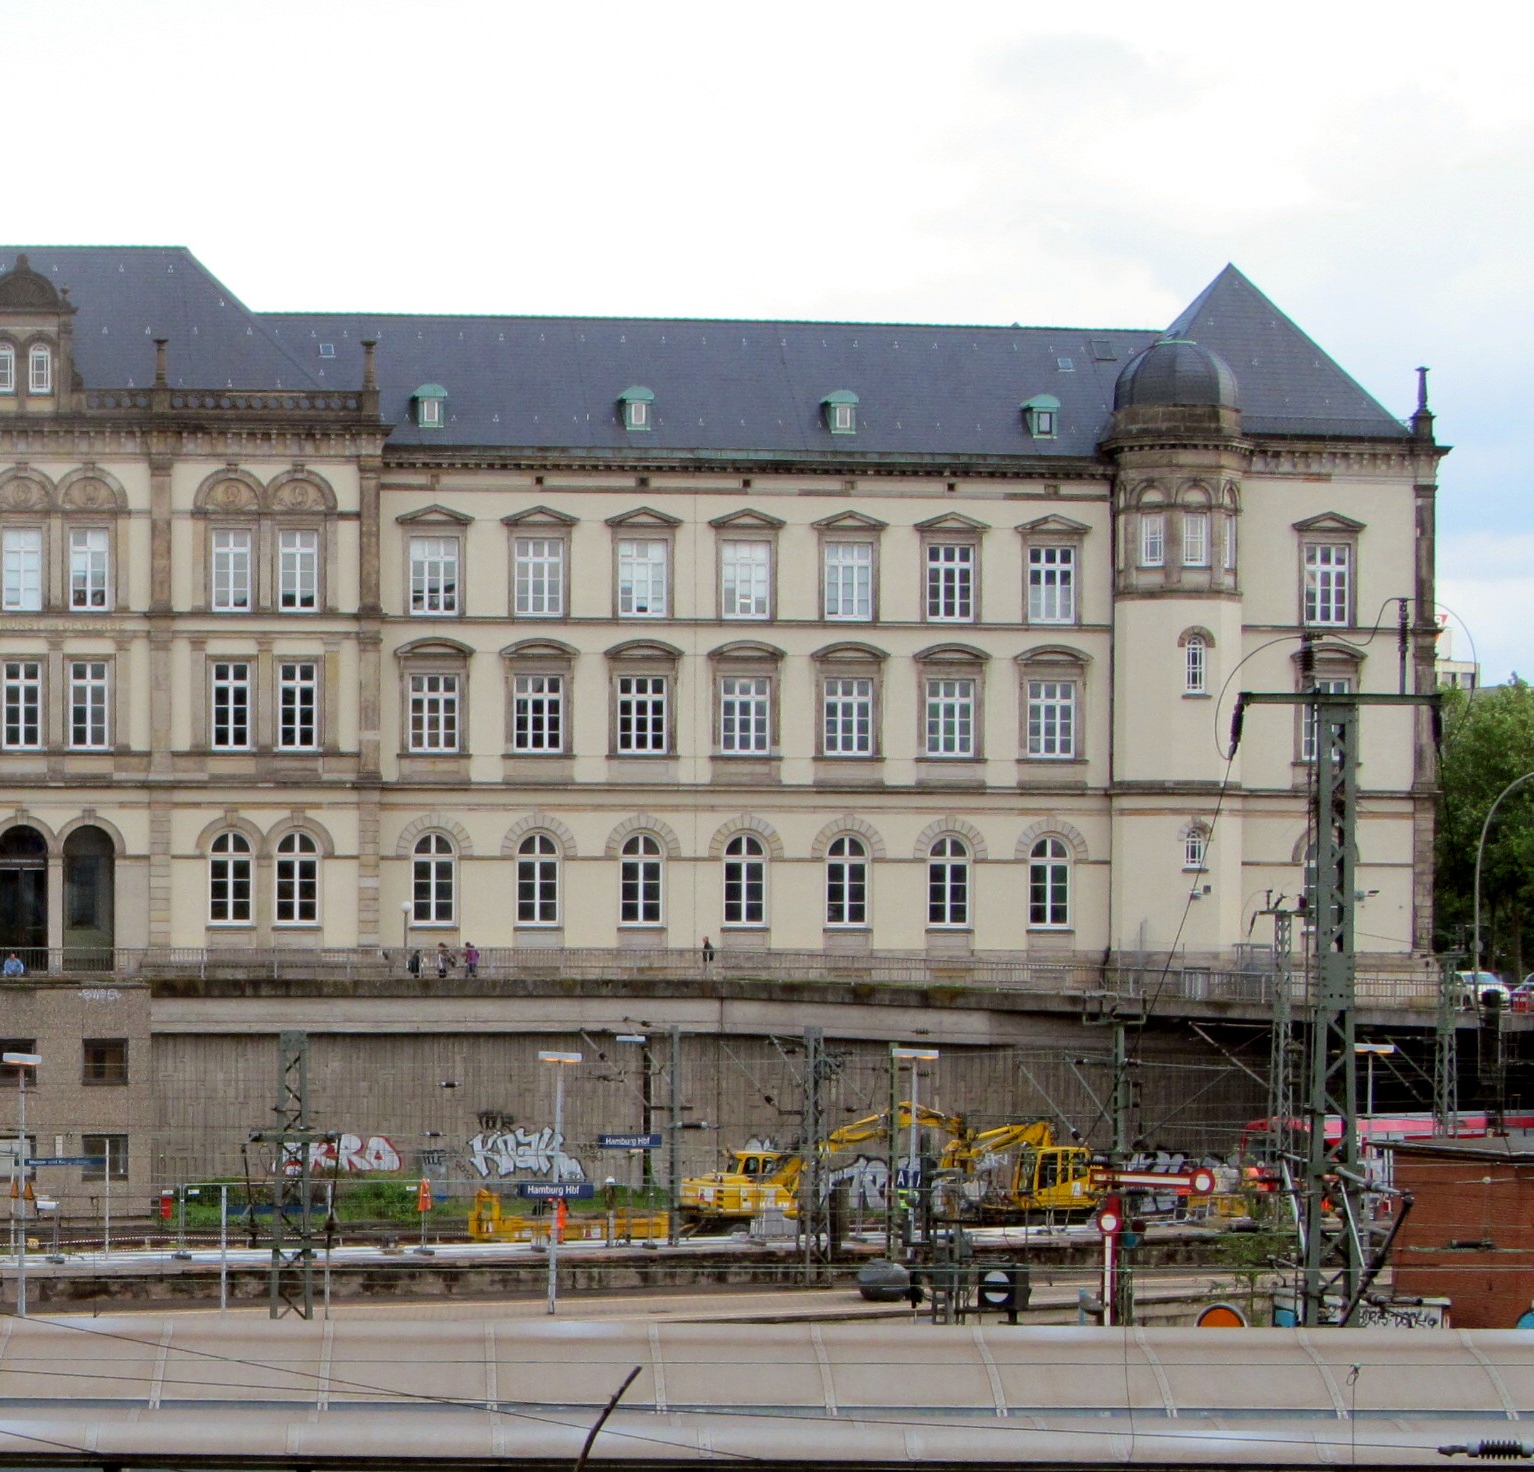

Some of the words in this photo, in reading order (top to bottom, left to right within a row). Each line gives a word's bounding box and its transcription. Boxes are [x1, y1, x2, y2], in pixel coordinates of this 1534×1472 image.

[606, 1137, 637, 1146] Hamburg
[527, 1185, 564, 1196] Hamburg
[566, 1185, 579, 1194] Hbf
